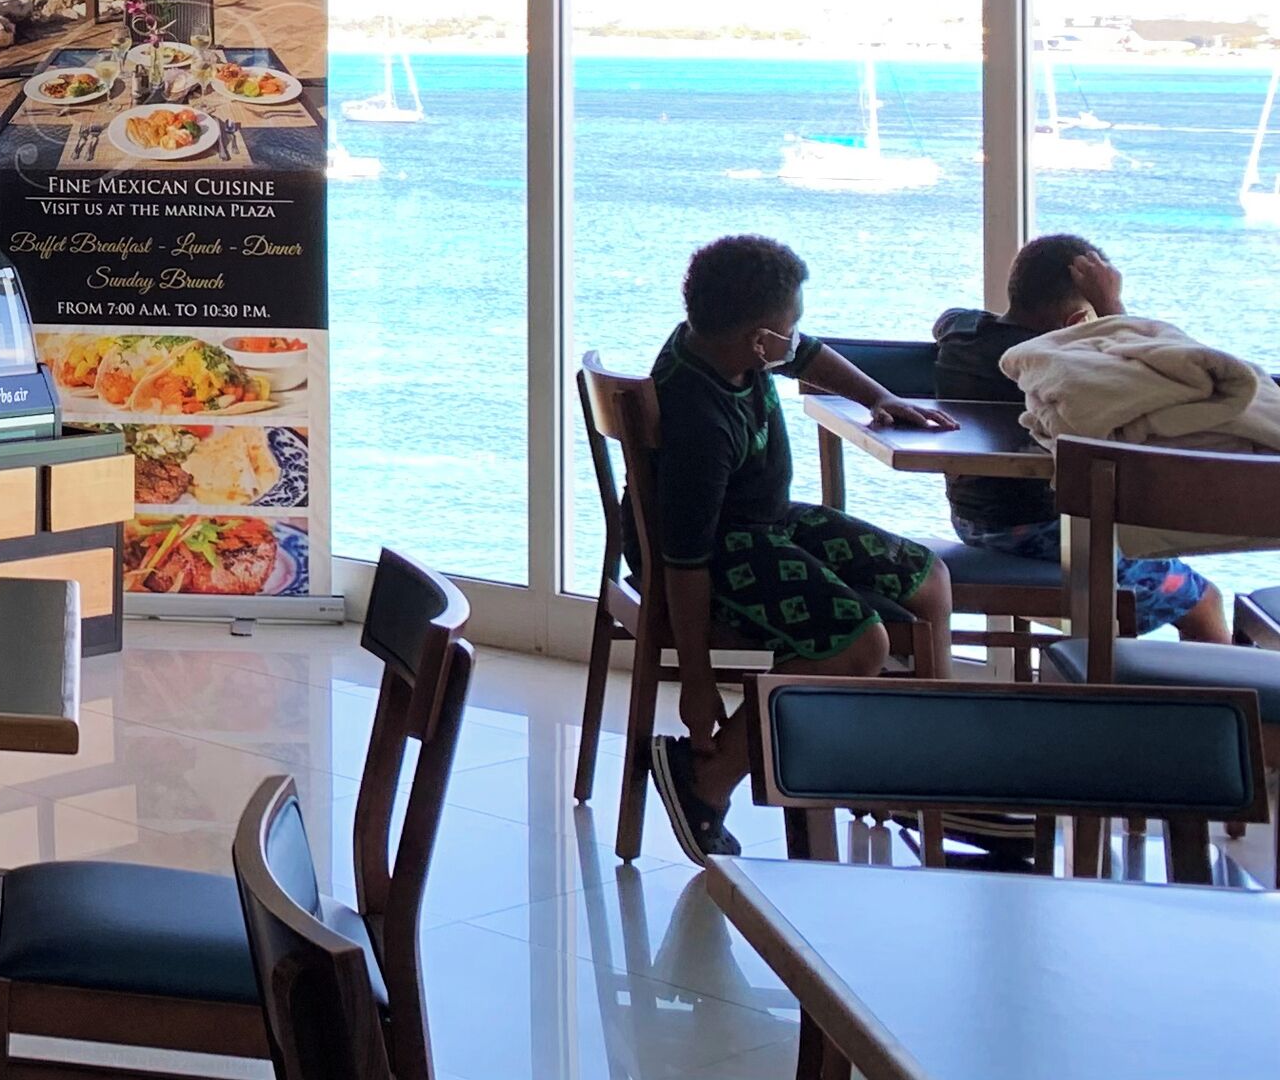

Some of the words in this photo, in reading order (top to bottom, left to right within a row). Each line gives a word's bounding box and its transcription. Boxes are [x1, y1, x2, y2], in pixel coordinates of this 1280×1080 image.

[48, 177, 91, 193] FINE
[97, 178, 188, 195] MEXICAN
[194, 178, 275, 196] CUISINE
[40, 201, 80, 215] VISIT
[85, 203, 103, 215] US
[107, 204, 125, 216] AT
[129, 204, 160, 216] THE
[165, 204, 226, 217] MARINA
[230, 203, 276, 218] PLAZA
[9, 231, 67, 260] Buffet
[70, 232, 153, 261] Breakfast
[170, 232, 222, 260] Lunch
[242, 234, 304, 257] Dinner
[86, 266, 154, 295] Sunday
[159, 268, 224, 290] Brunch
[57, 302, 102, 315] FROM
[108, 302, 135, 315] 7:00
[139, 303, 171, 317] A.M.
[175, 304, 197, 317] TO
[202, 304, 238, 318] 10:30
[243, 304, 271, 318] P.M.
